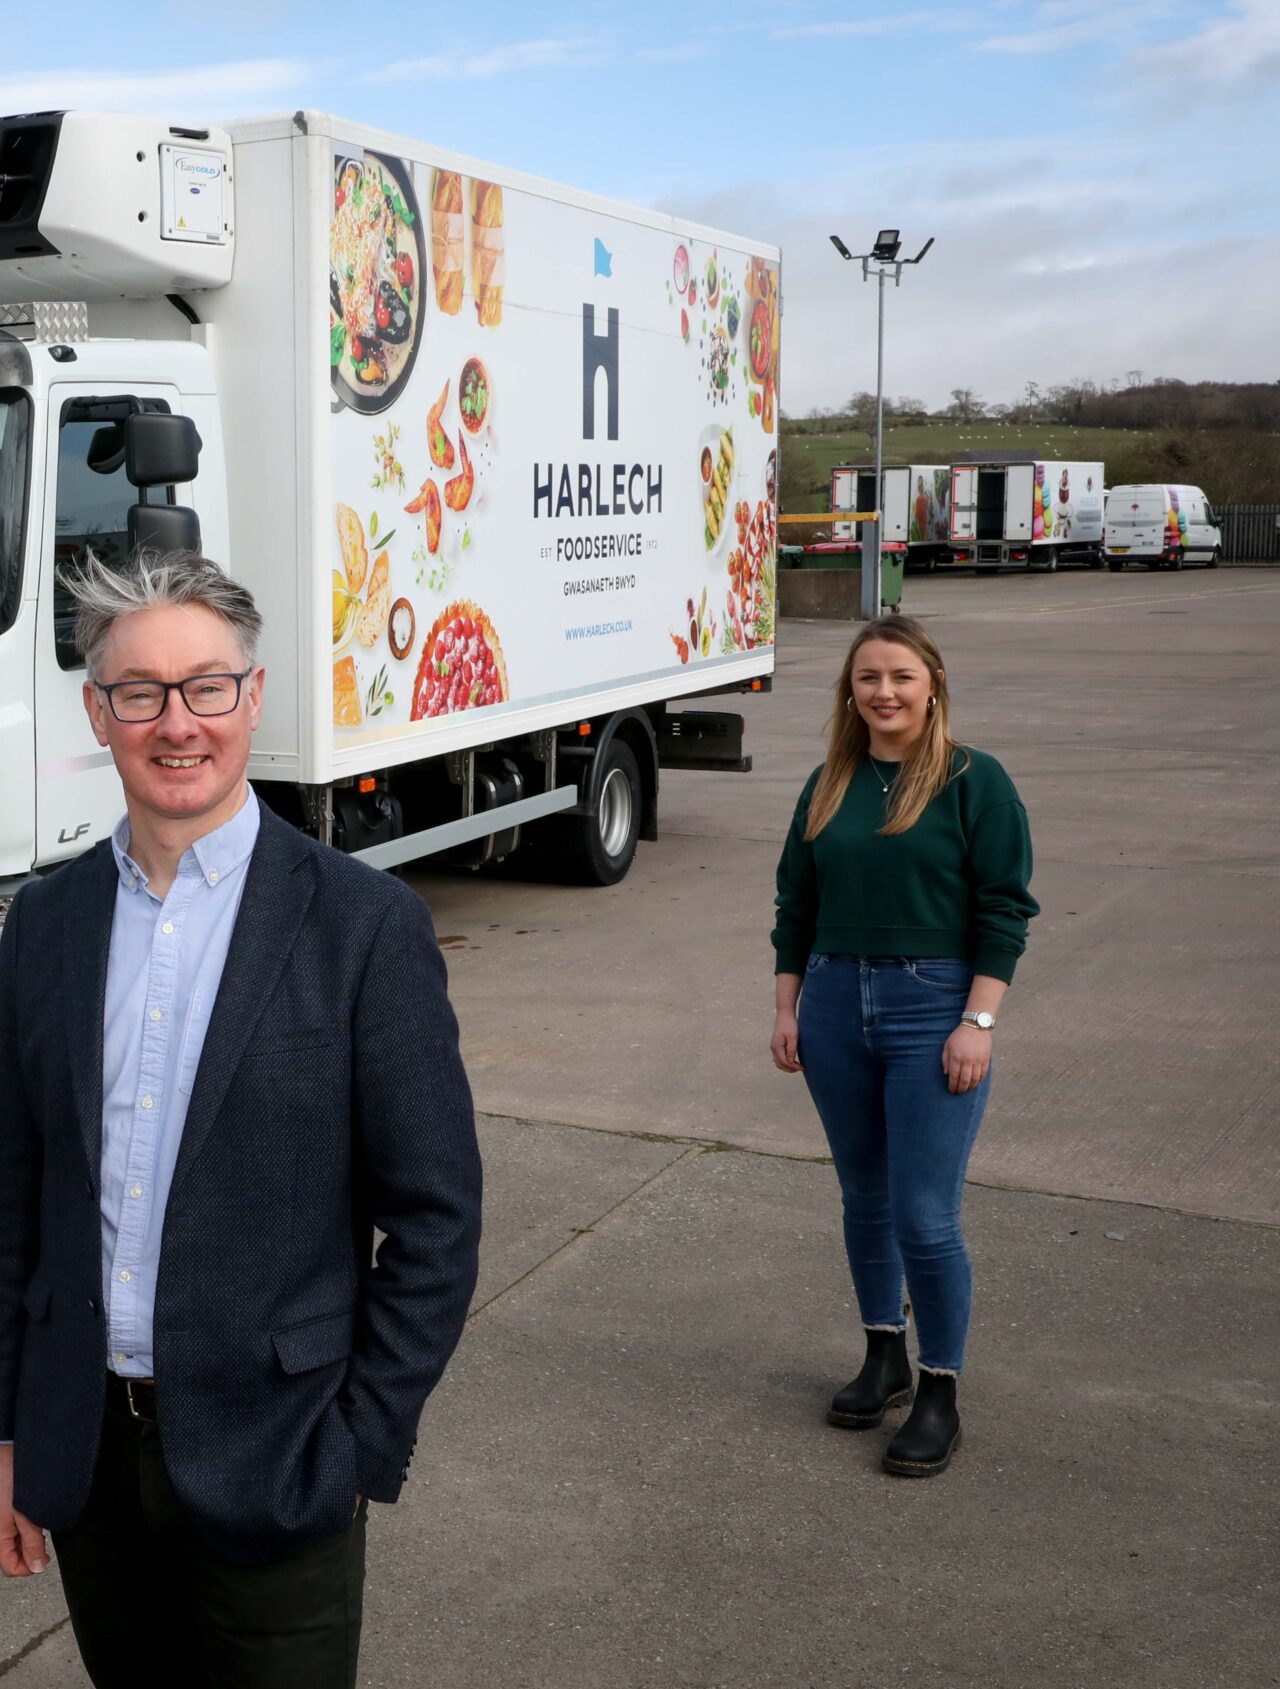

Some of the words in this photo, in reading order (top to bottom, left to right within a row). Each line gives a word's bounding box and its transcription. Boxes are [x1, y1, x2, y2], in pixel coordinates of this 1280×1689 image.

[533, 463, 663, 518] HARLECH
[540, 548, 553, 559] EST
[557, 533, 642, 562] FOODSERVICE
[563, 577, 614, 596] GWASANAETH
[615, 575, 636, 590] BWYD
[565, 620, 633, 641] WWW.HARLECH.CO.UK
[58, 822, 91, 844] LF
